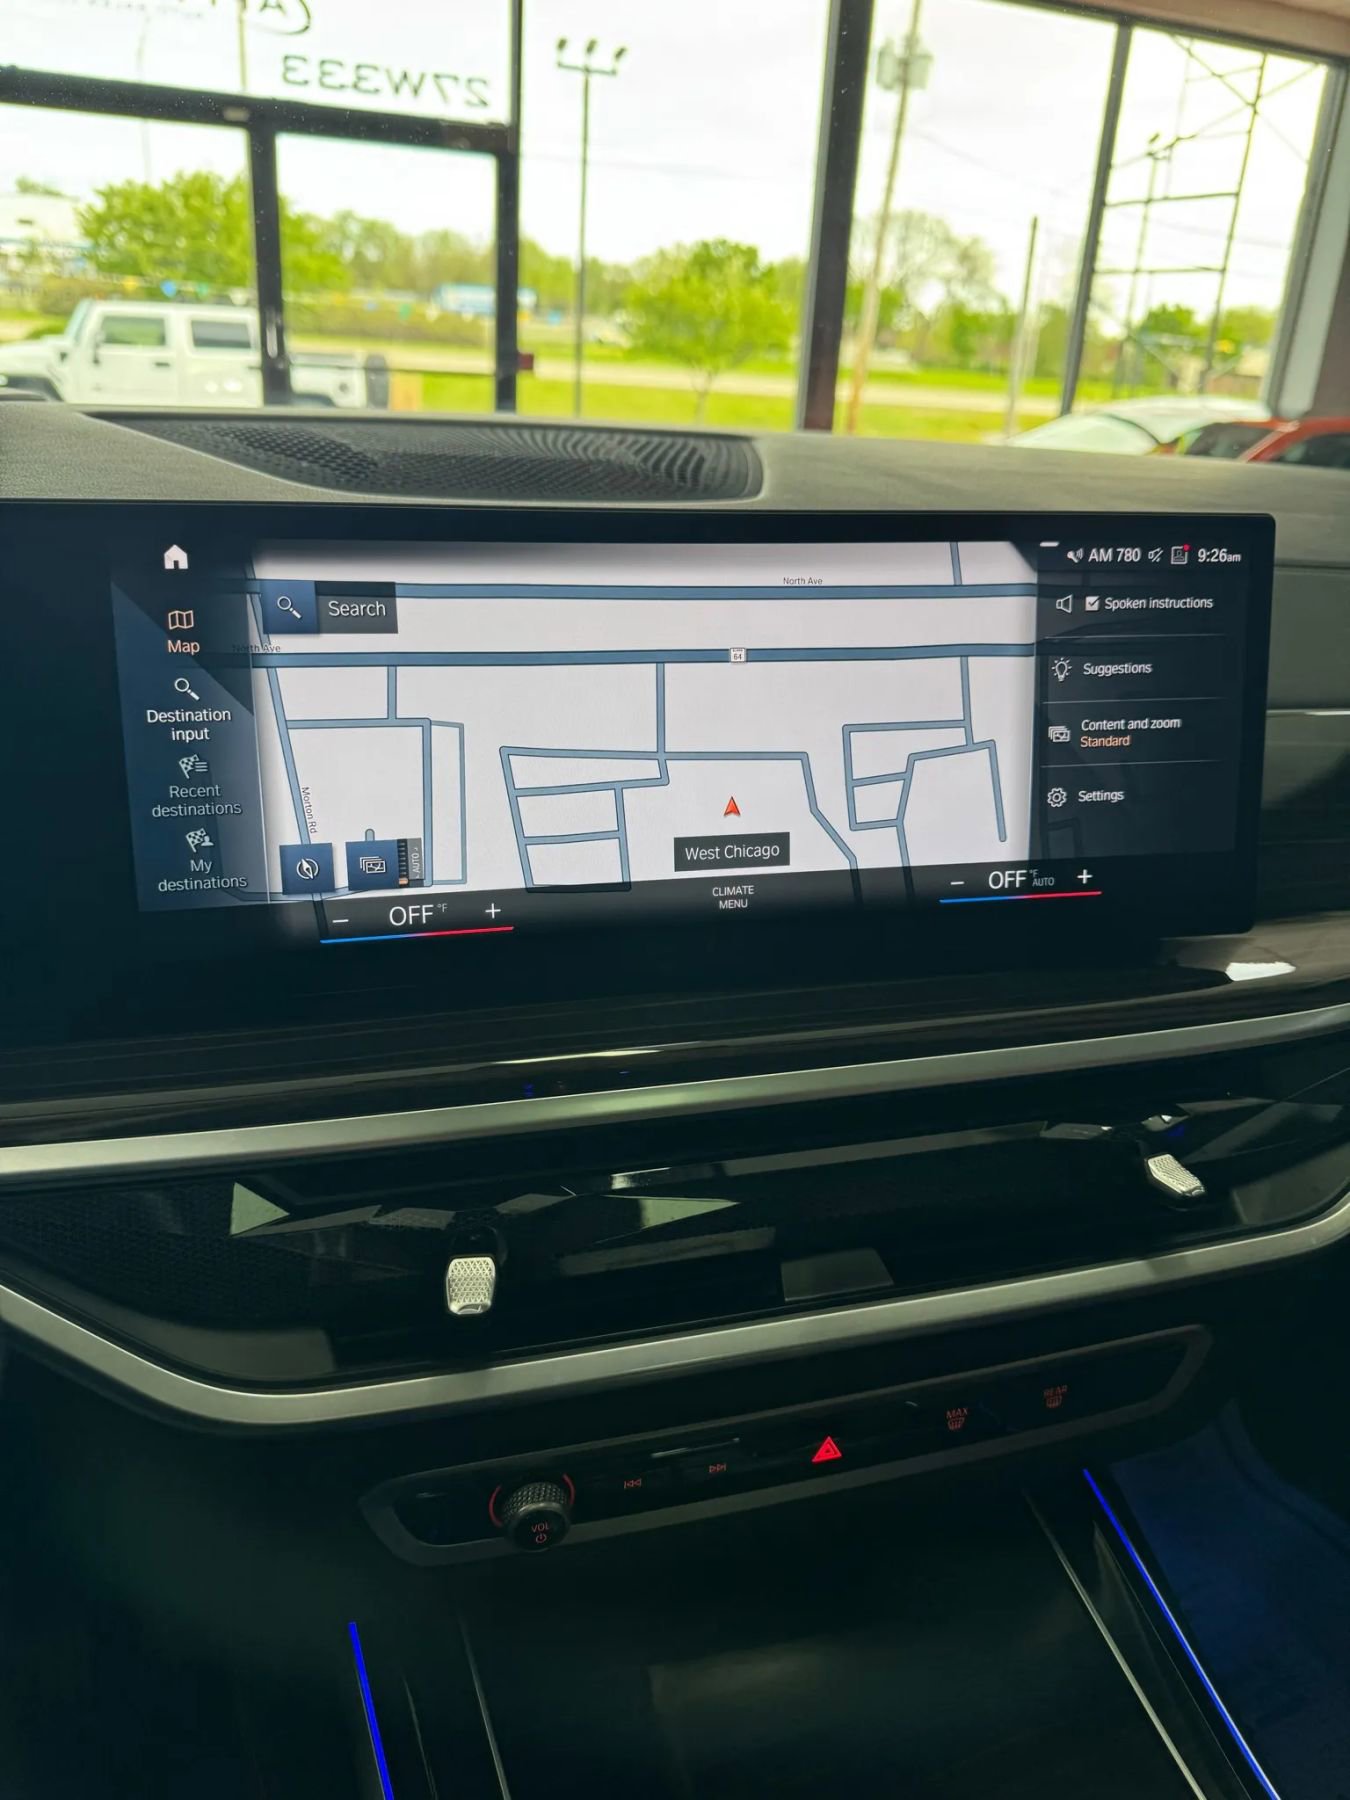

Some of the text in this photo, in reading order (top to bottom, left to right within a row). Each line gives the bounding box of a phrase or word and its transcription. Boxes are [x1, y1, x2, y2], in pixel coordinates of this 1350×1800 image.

[1088, 548, 1141, 562] AM 780
[1197, 548, 1242, 563] 9:26am
[783, 576, 823, 585] North Ave
[328, 600, 387, 617] Search
[1104, 596, 1214, 611] Spoken instructions
[167, 639, 200, 656] Map
[263, 643, 281, 653] Ave
[1083, 662, 1152, 677] Suggestions
[146, 708, 232, 725] Destination
[1081, 718, 1182, 731] Content and zoom
[171, 727, 210, 743] input
[1080, 735, 1131, 748] Standard
[168, 784, 222, 800] Recent
[1078, 790, 1125, 804] Settings
[151, 800, 242, 819] destinations
[301, 786, 318, 834] Morton Rd
[685, 842, 780, 861] West Chicago
[189, 858, 213, 875] My
[411, 852, 421, 874] AUTO
[157, 874, 248, 893] destinations
[988, 869, 1028, 889] OFF
[1032, 877, 1055, 887] AUTO
[712, 884, 755, 897] CLIMATE
[718, 898, 749, 910] MENU
[389, 904, 434, 927] OFF
[946, 1407, 968, 1419] MAX
[531, 1521, 550, 1533] VOL
